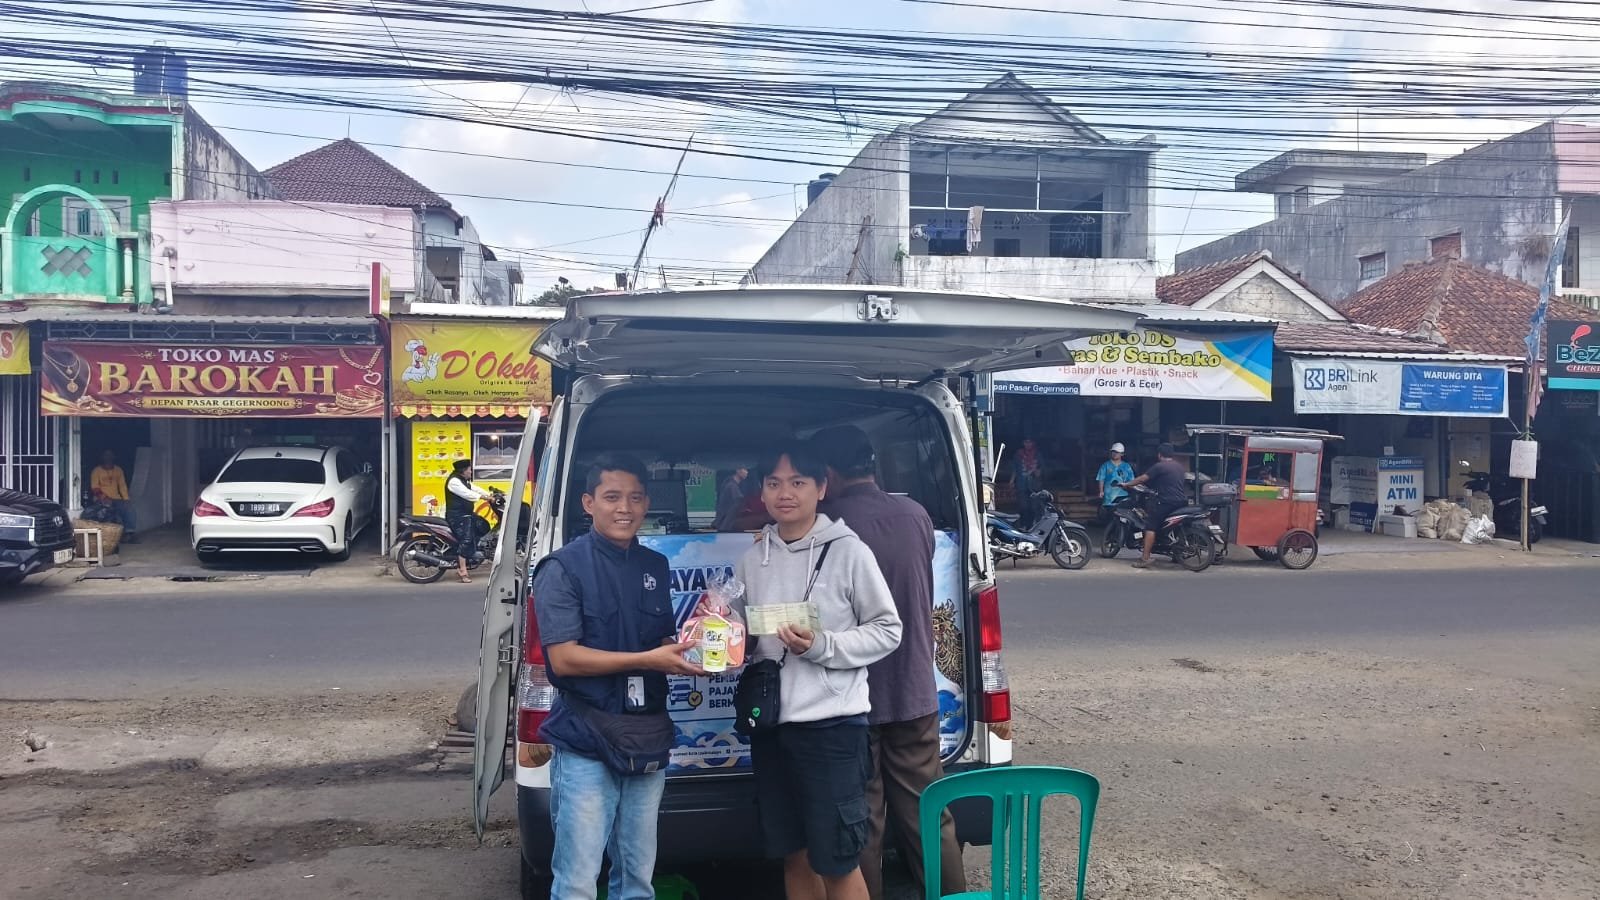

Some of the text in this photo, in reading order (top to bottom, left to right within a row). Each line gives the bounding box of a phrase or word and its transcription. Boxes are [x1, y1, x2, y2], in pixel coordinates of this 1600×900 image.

[1143, 330, 1176, 347] DS
[158, 348, 276, 363] TOKO MAS
[1101, 346, 1121, 362] &
[1124, 347, 1221, 367] Sembako
[441, 350, 540, 380] D'Okeh
[97, 361, 338, 396] BAROKAH
[1064, 366, 1198, 379] Bahan Kue Plastik Snack
[1423, 370, 1482, 381] WARUNG DITA
[1009, 384, 1031, 392] Pasar
[1033, 384, 1079, 394] Gegernoong
[1094, 379, 1127, 389] (Grosir
[1139, 380, 1163, 391] Ecer)
[1328, 384, 1348, 392] Agen
[150, 399, 290, 407] DEPAN PASAR GEGERNOONG
[1390, 475, 1414, 485] MINI
[1386, 487, 1417, 500] ATM
